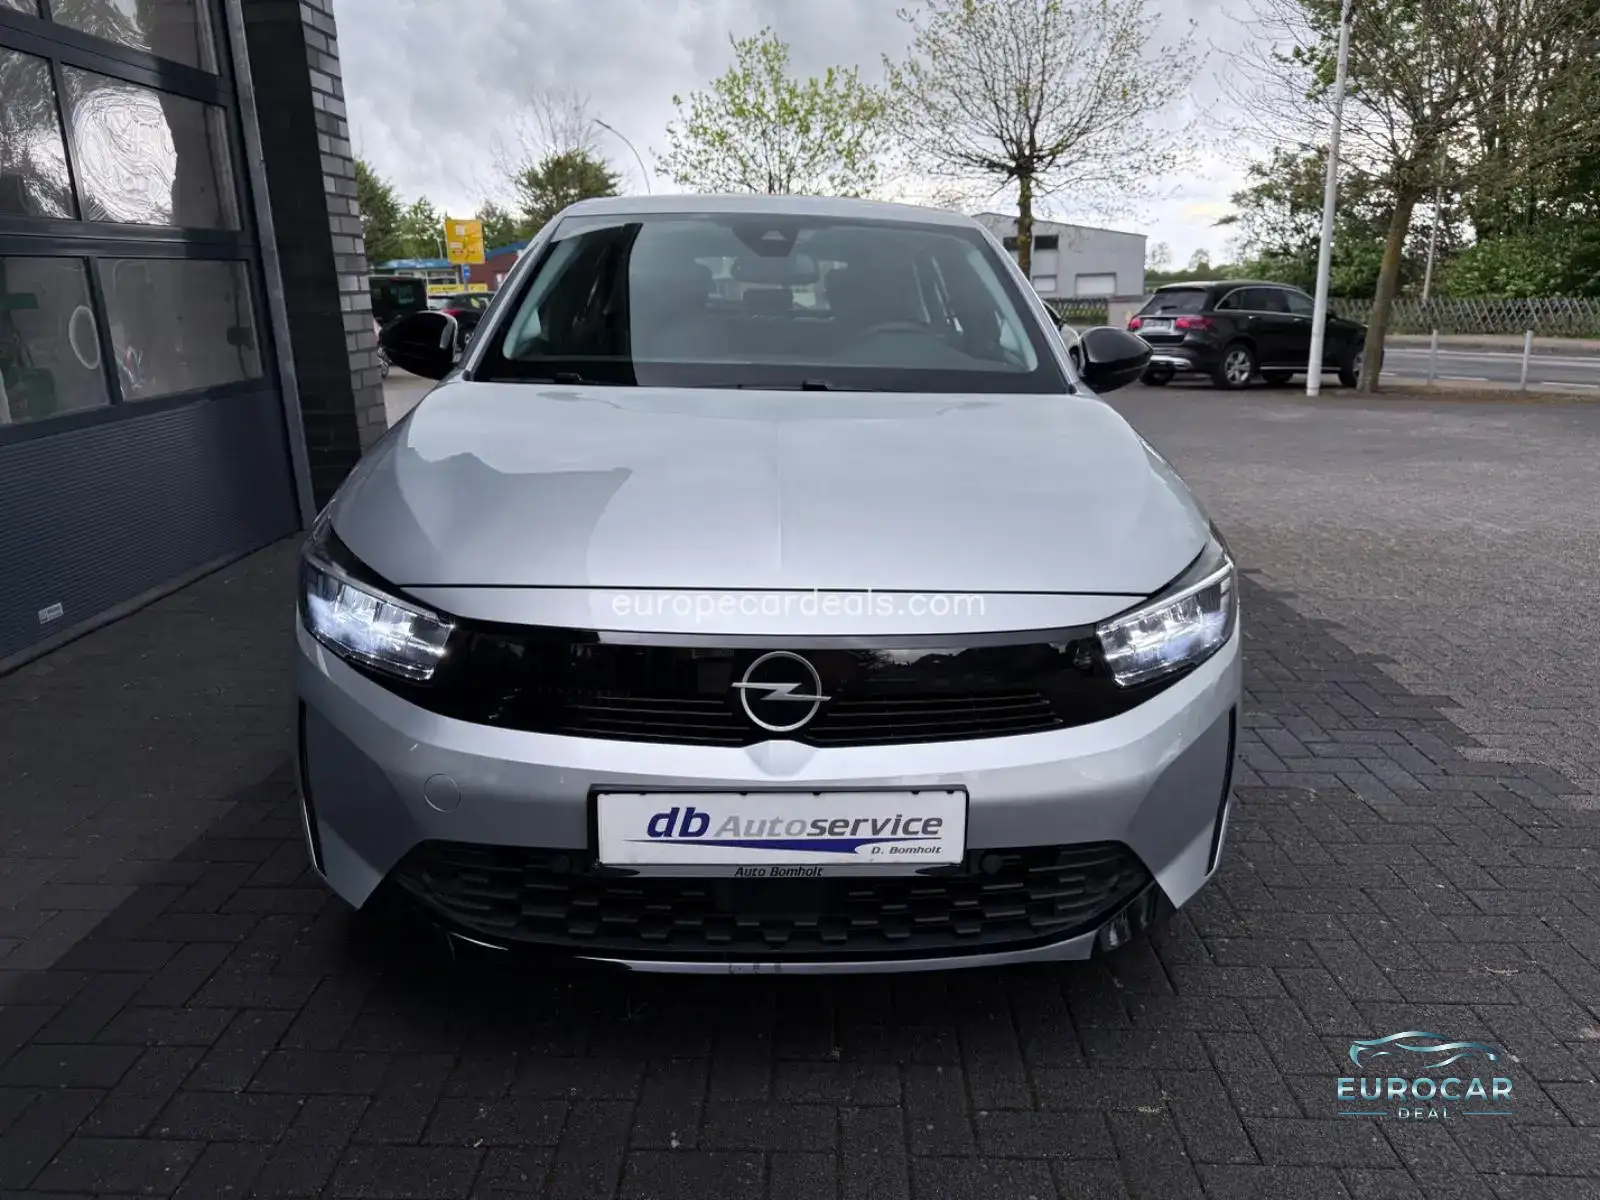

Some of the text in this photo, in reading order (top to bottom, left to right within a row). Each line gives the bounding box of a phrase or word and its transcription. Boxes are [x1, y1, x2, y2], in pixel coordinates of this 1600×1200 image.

[646, 807, 943, 838] db Autoservice
[871, 846, 942, 855] D. Bomholt
[734, 865, 824, 877] Auto Bomholt
